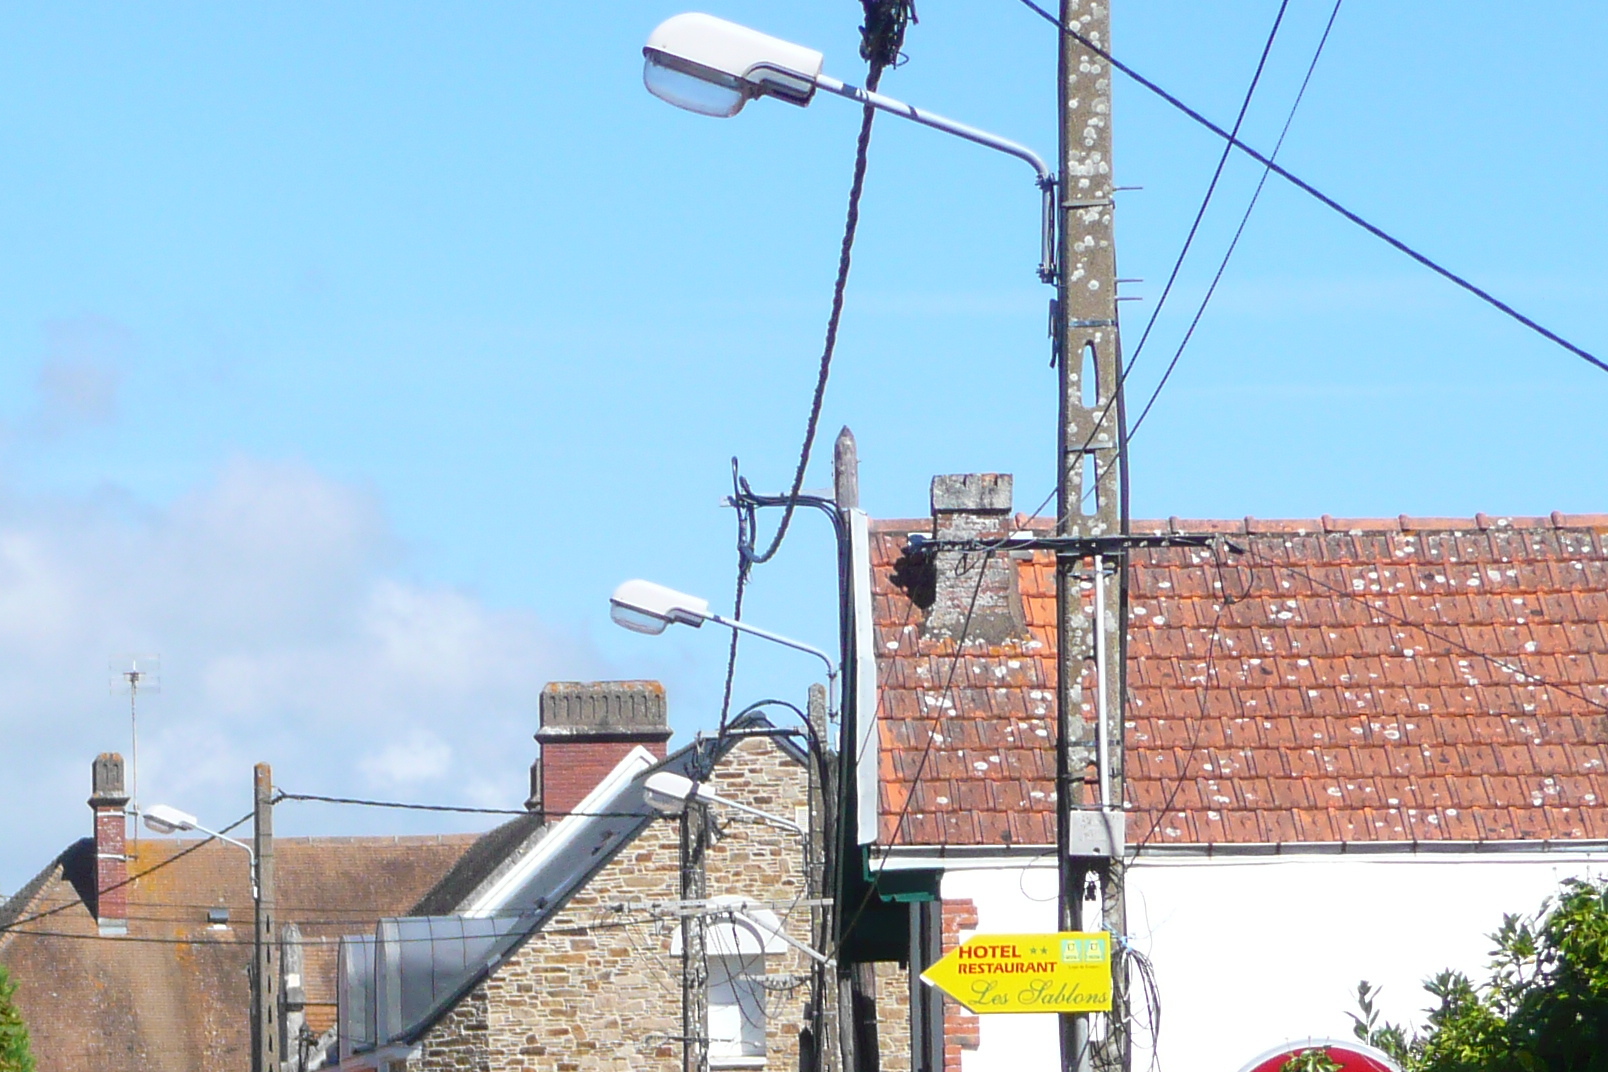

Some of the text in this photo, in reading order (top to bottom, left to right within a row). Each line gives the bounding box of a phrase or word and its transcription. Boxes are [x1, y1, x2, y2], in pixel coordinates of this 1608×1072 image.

[958, 944, 1022, 960] HOTEL
[958, 961, 1058, 975] RESTAURANT
[967, 978, 1109, 1006] Les Sablons
